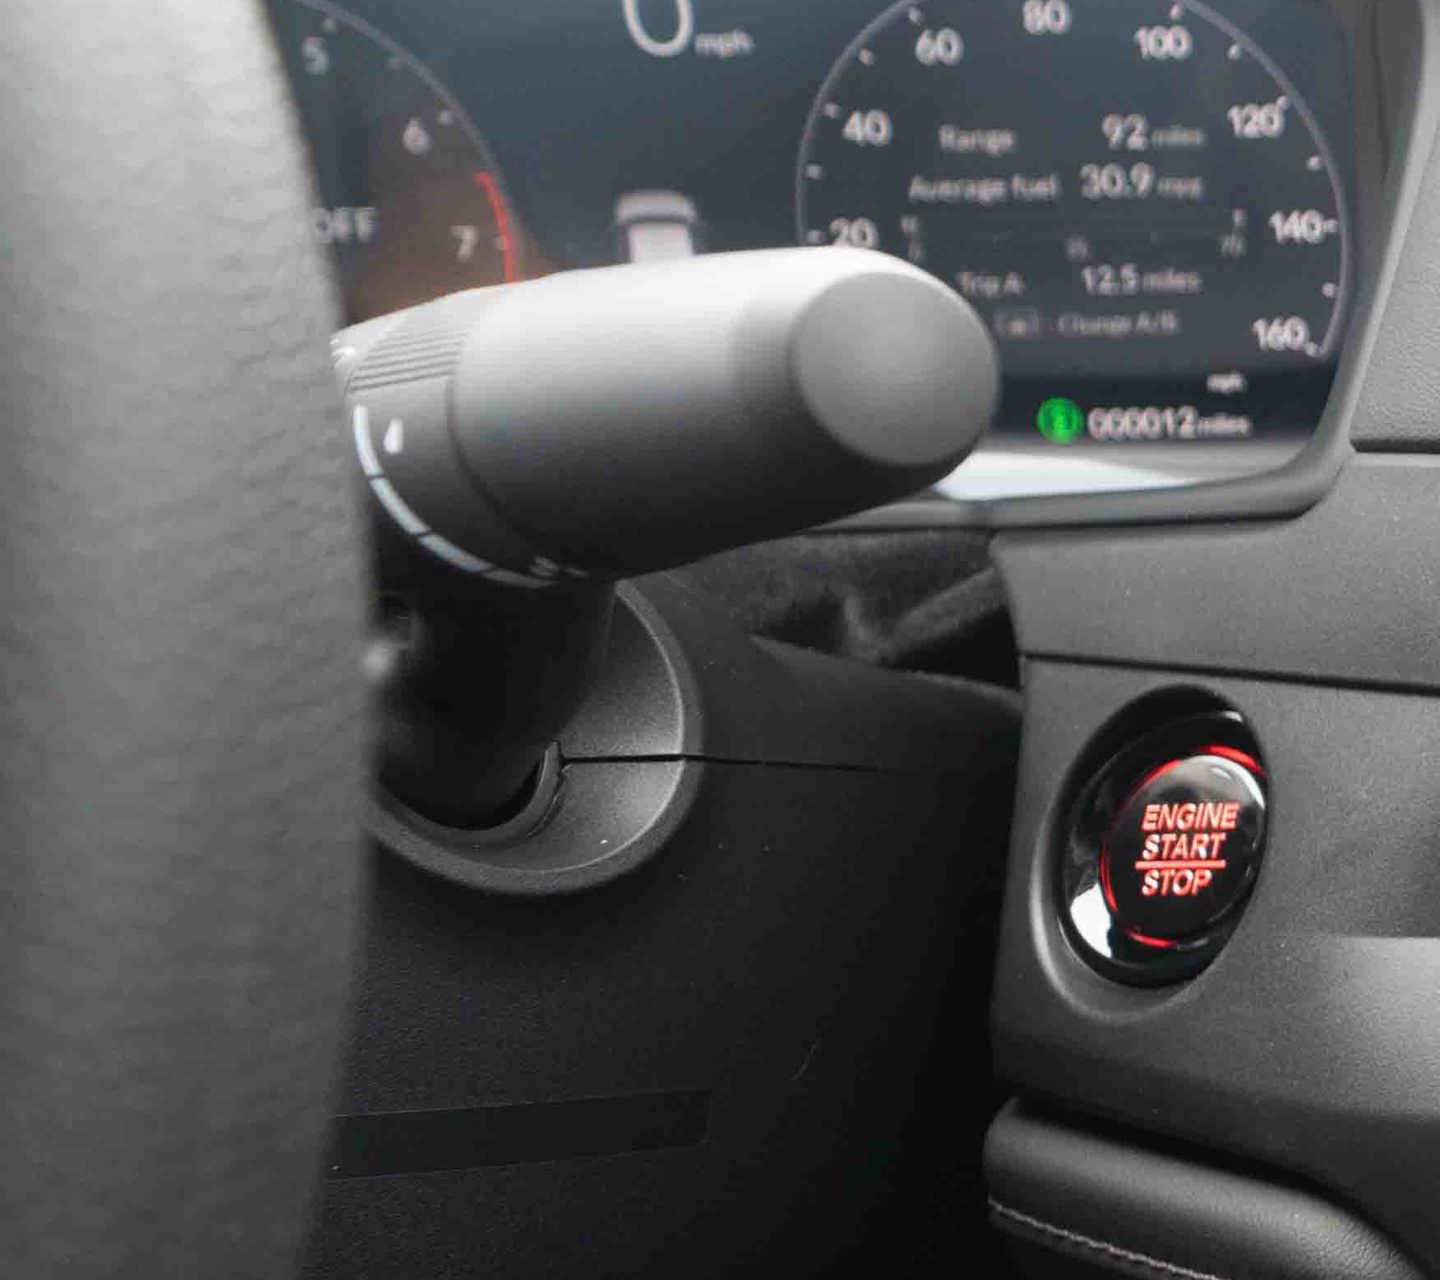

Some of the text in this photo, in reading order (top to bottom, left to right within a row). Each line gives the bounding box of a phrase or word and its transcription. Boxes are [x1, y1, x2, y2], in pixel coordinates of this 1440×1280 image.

[915, 29, 963, 65] 60
[1135, 25, 1193, 60] 100
[843, 110, 893, 146] 40
[1103, 114, 1149, 150] 92
[1228, 104, 1284, 138] 120
[1270, 210, 1324, 244] 140
[1253, 317, 1310, 352] 160
[1141, 802, 1241, 831] ENGINE
[1142, 832, 1227, 860] START
[1141, 869, 1213, 897] STOP
